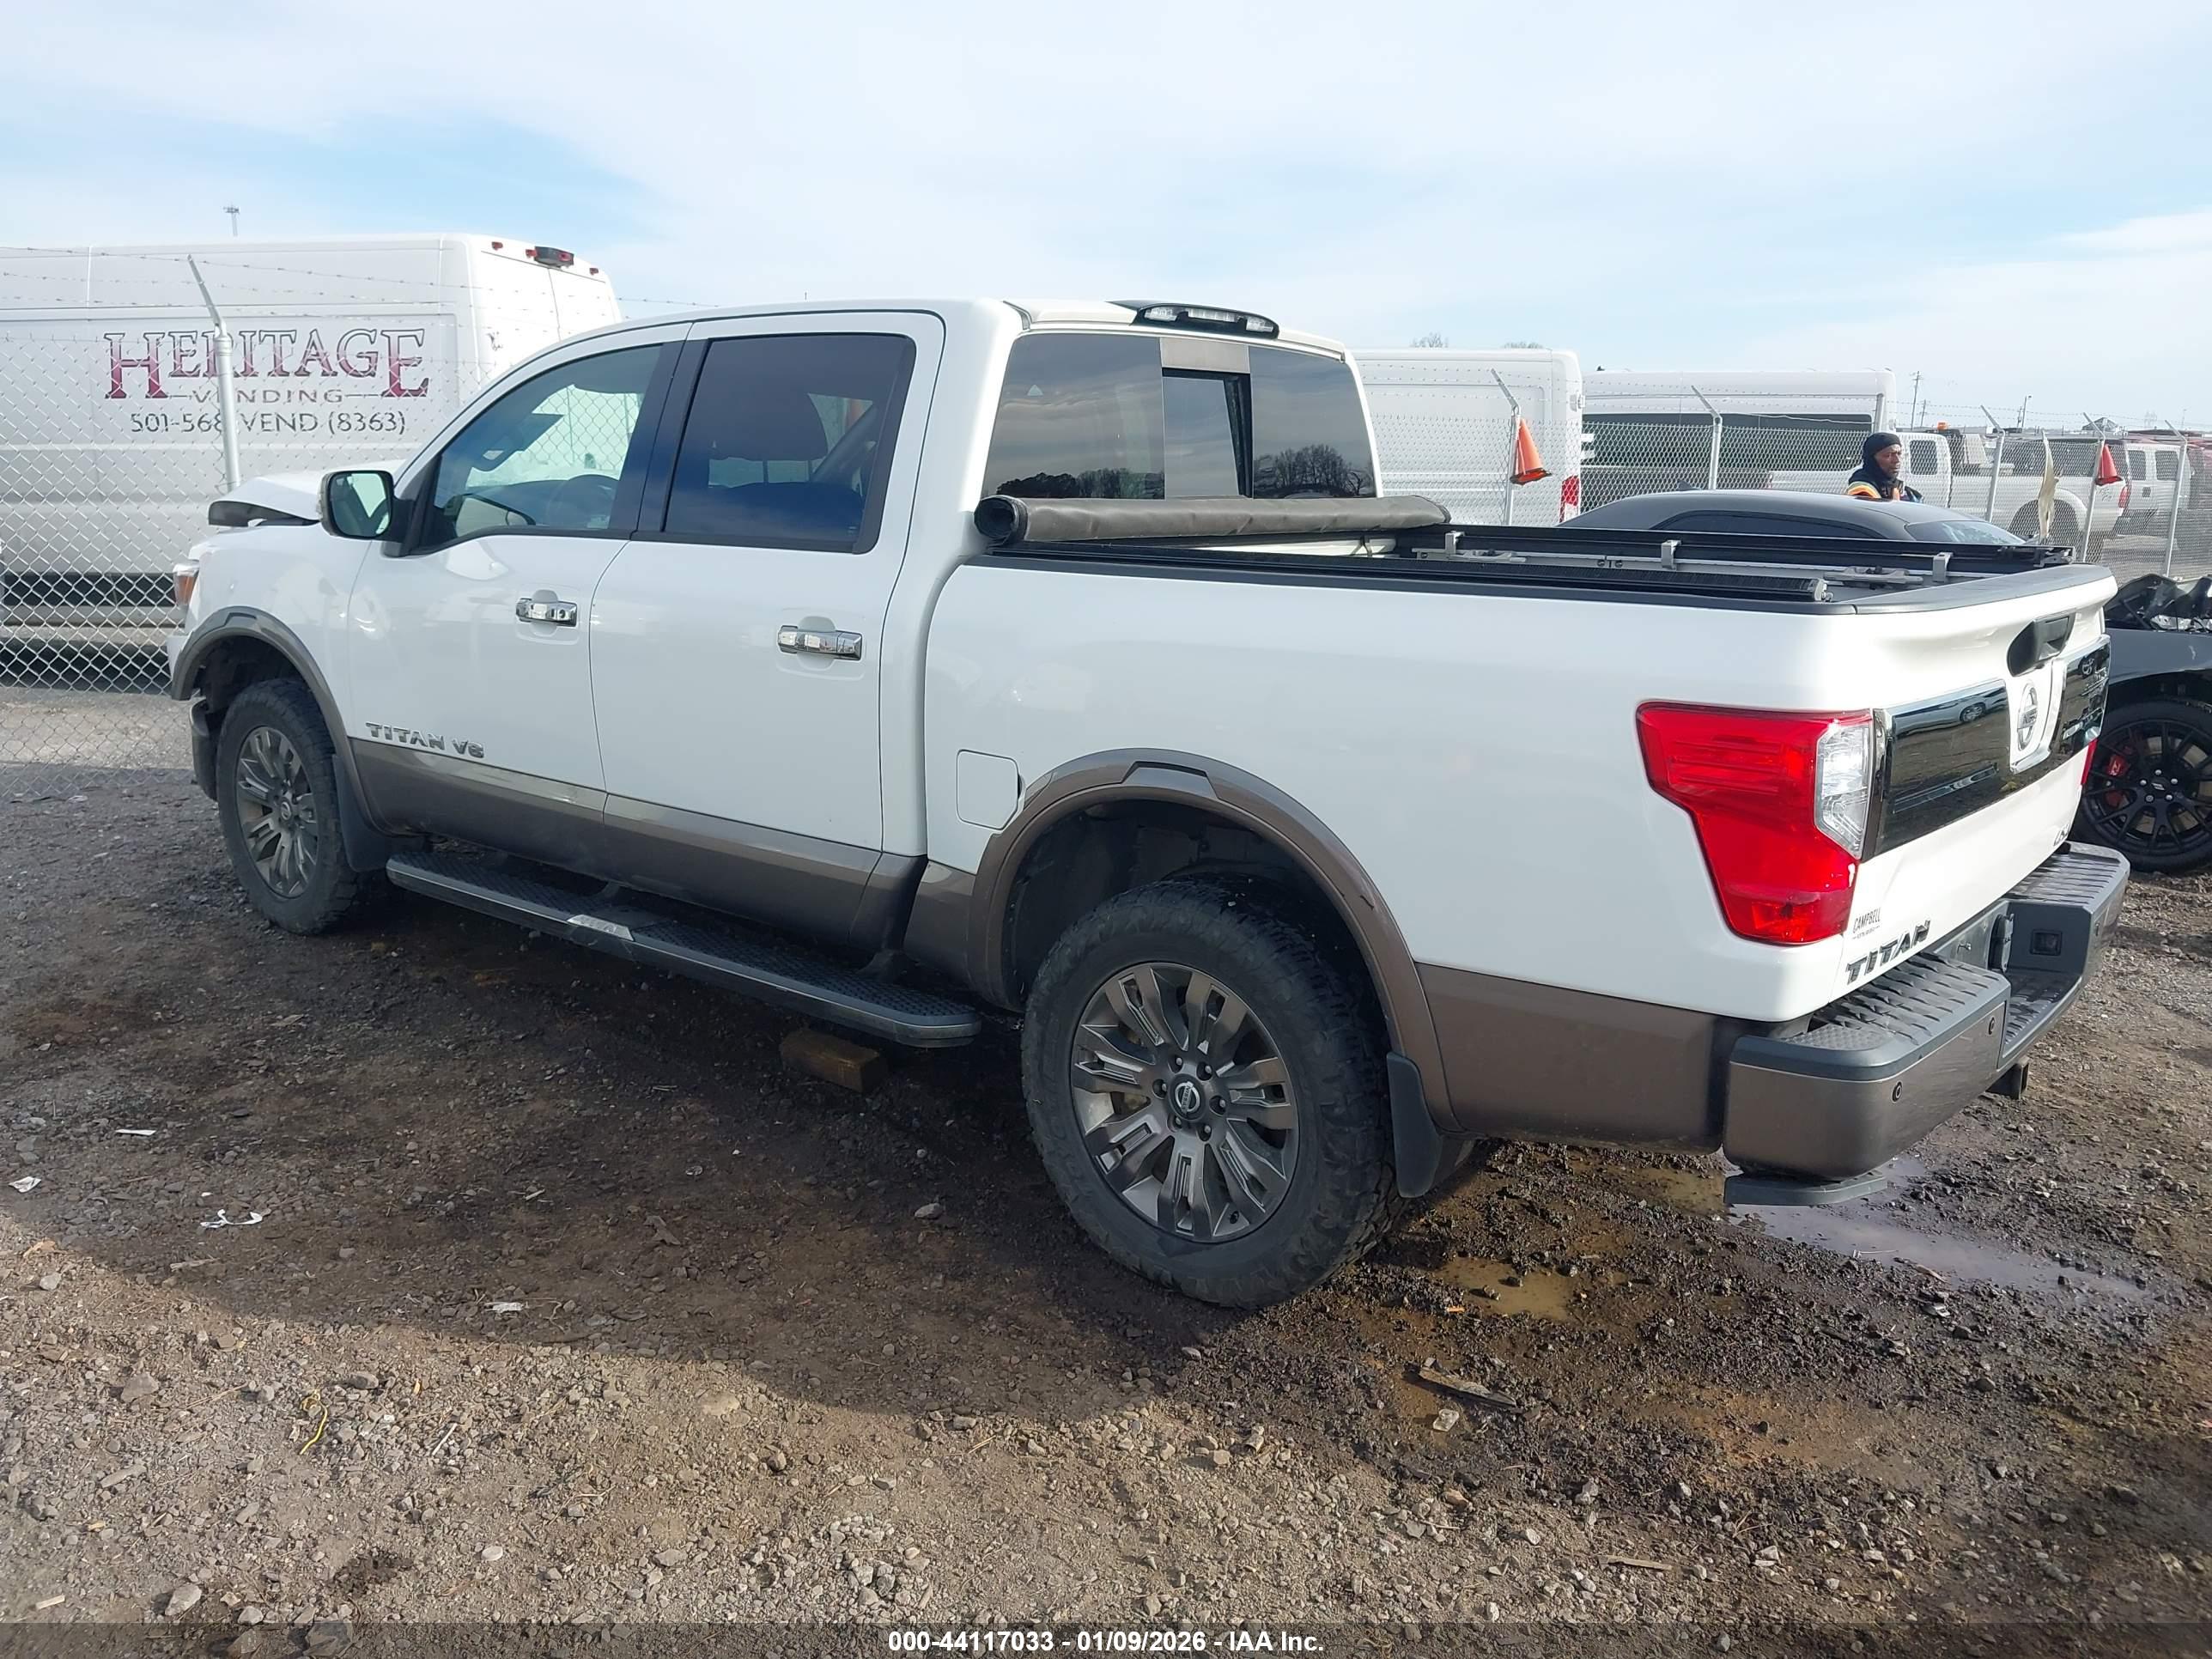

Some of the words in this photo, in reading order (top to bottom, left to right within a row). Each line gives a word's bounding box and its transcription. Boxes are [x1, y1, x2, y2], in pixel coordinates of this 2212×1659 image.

[192, 389, 343, 404] VNDING
[329, 411, 405, 434] (8363)
[365, 722, 446, 750] TITAN
[1853, 908, 1881, 933] CAMPBELL
[1845, 920, 1931, 985] TITAN
